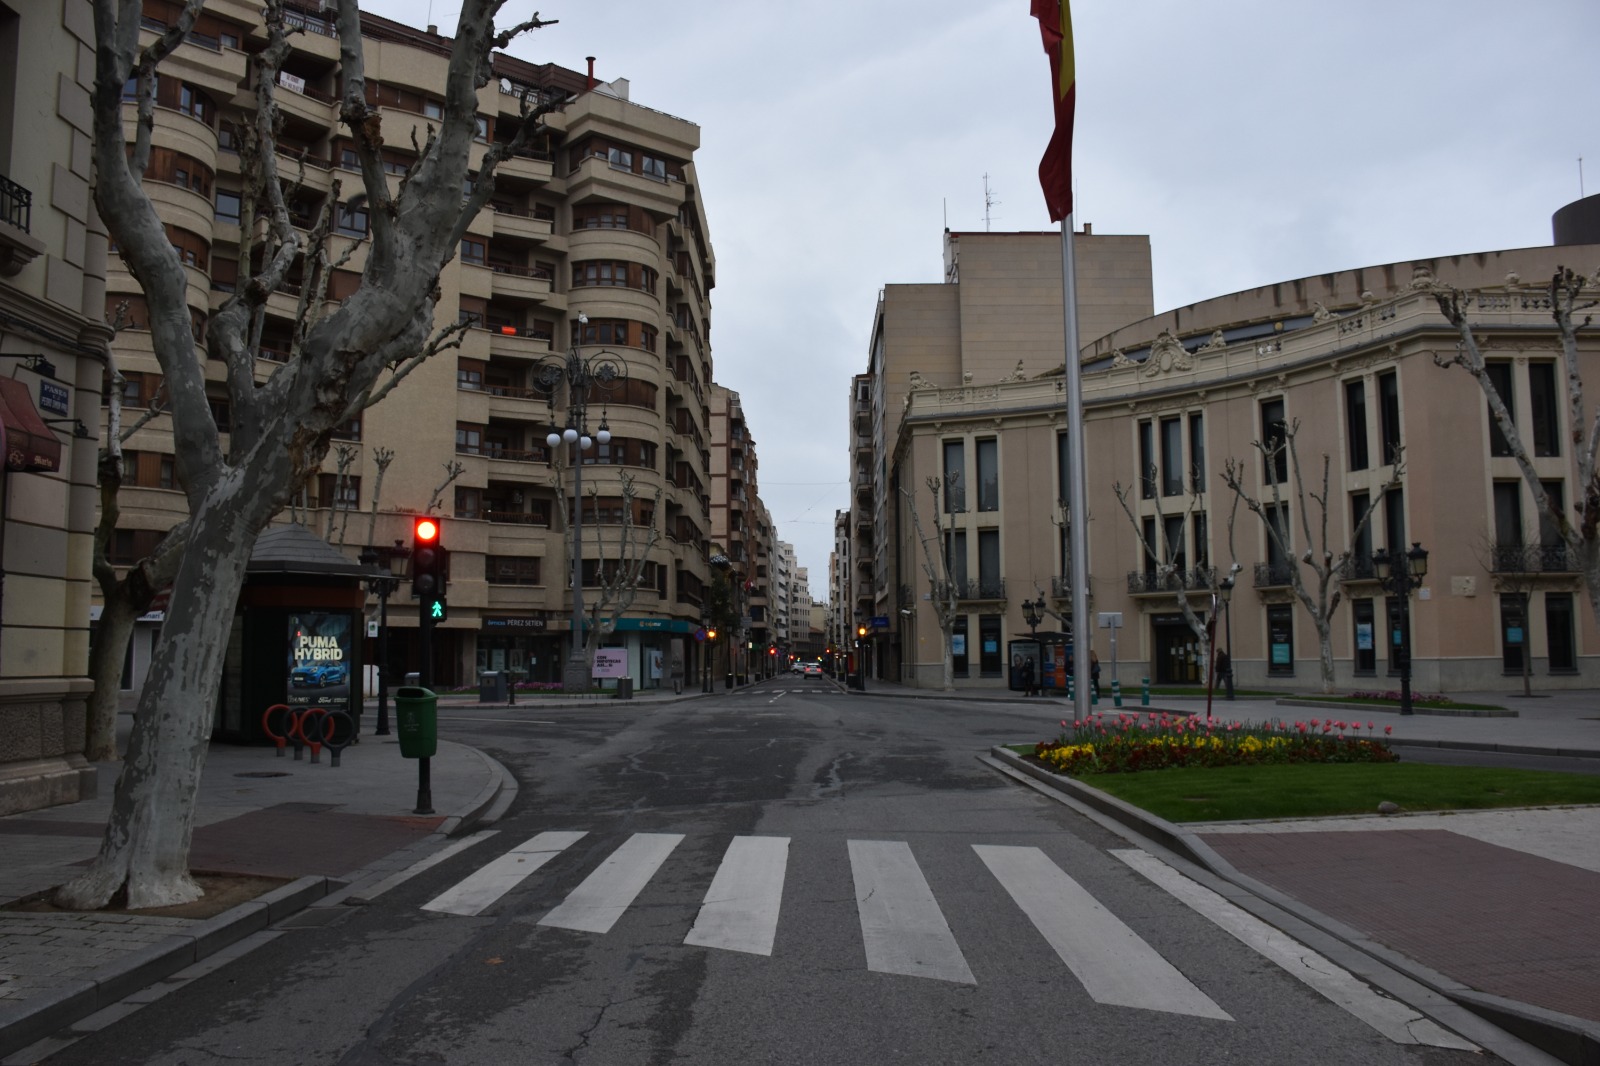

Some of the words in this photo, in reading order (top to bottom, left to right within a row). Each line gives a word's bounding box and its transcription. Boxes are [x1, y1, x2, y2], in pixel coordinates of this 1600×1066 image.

[44, 384, 68, 399] PASEO
[300, 635, 338, 648] PUMA
[294, 648, 343, 660] HYBRID
